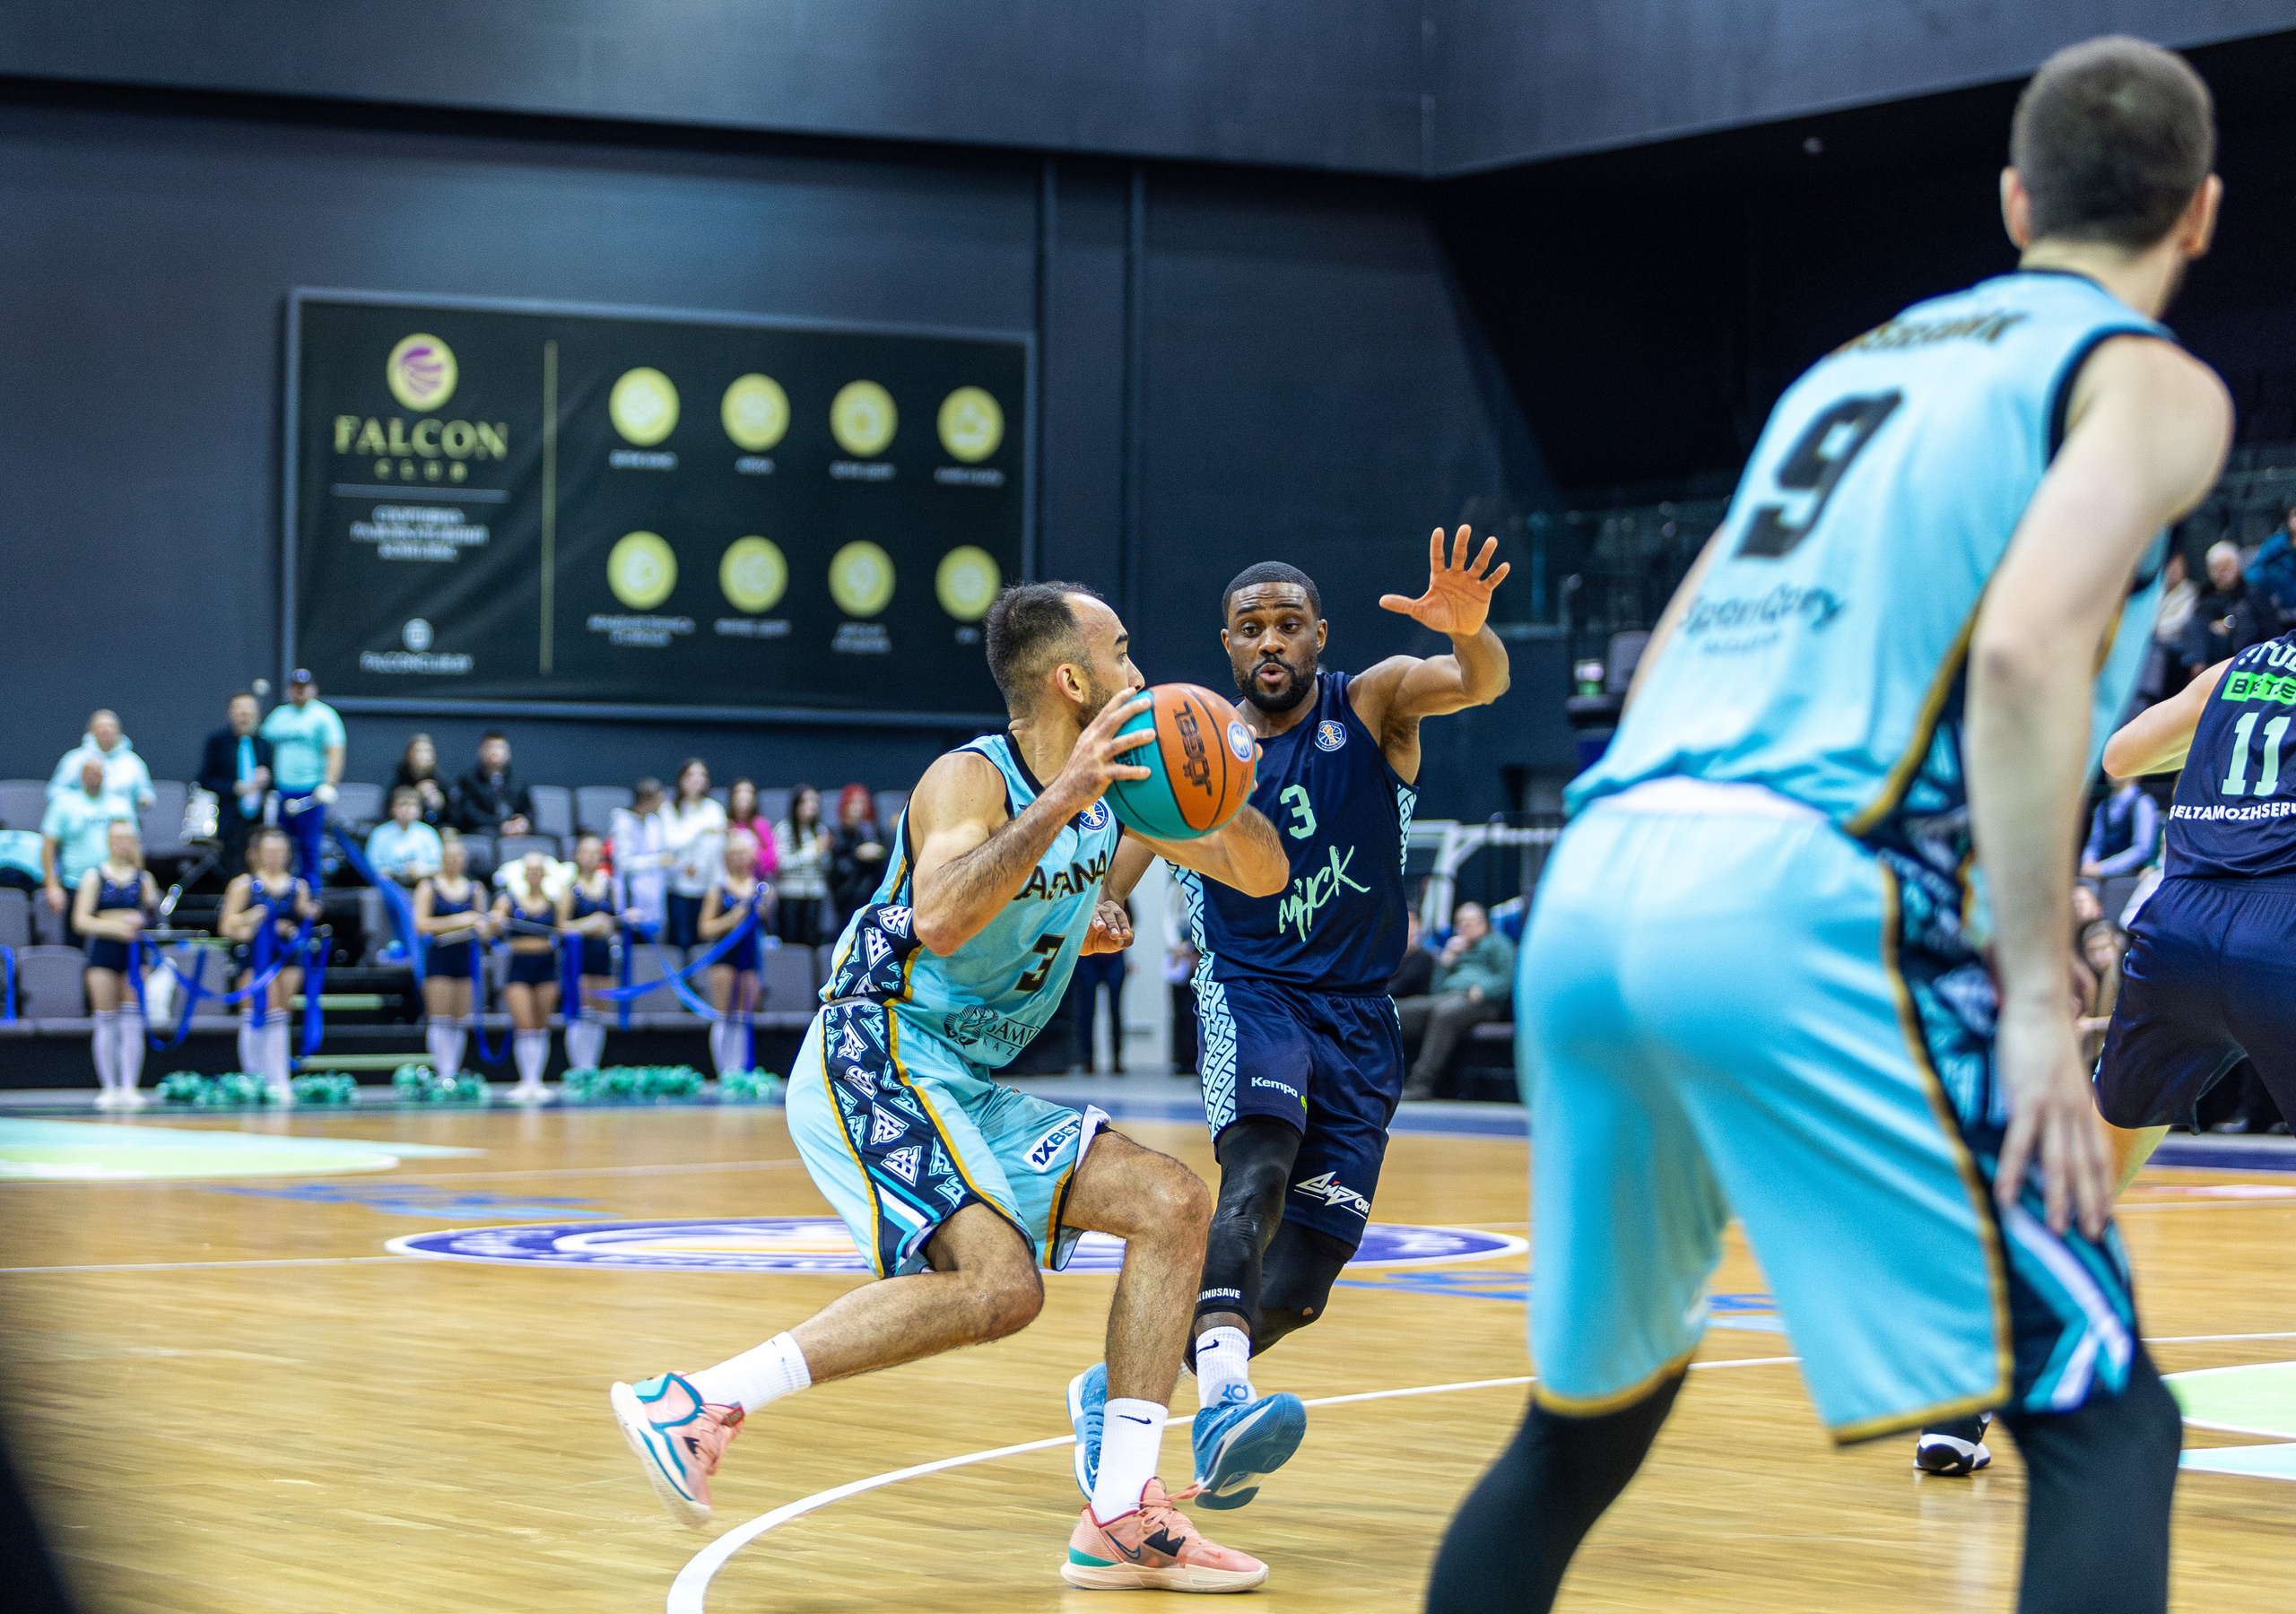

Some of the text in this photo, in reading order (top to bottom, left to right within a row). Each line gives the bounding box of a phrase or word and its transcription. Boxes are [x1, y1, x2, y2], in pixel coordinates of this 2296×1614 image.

[335, 415, 509, 462] FALCON
[1732, 386, 1904, 561] 9
[2222, 712, 2292, 796] 11
[1279, 784, 1318, 840] 3
[1013, 932, 1066, 993] 3
[1251, 1077, 1298, 1098] Kempa
